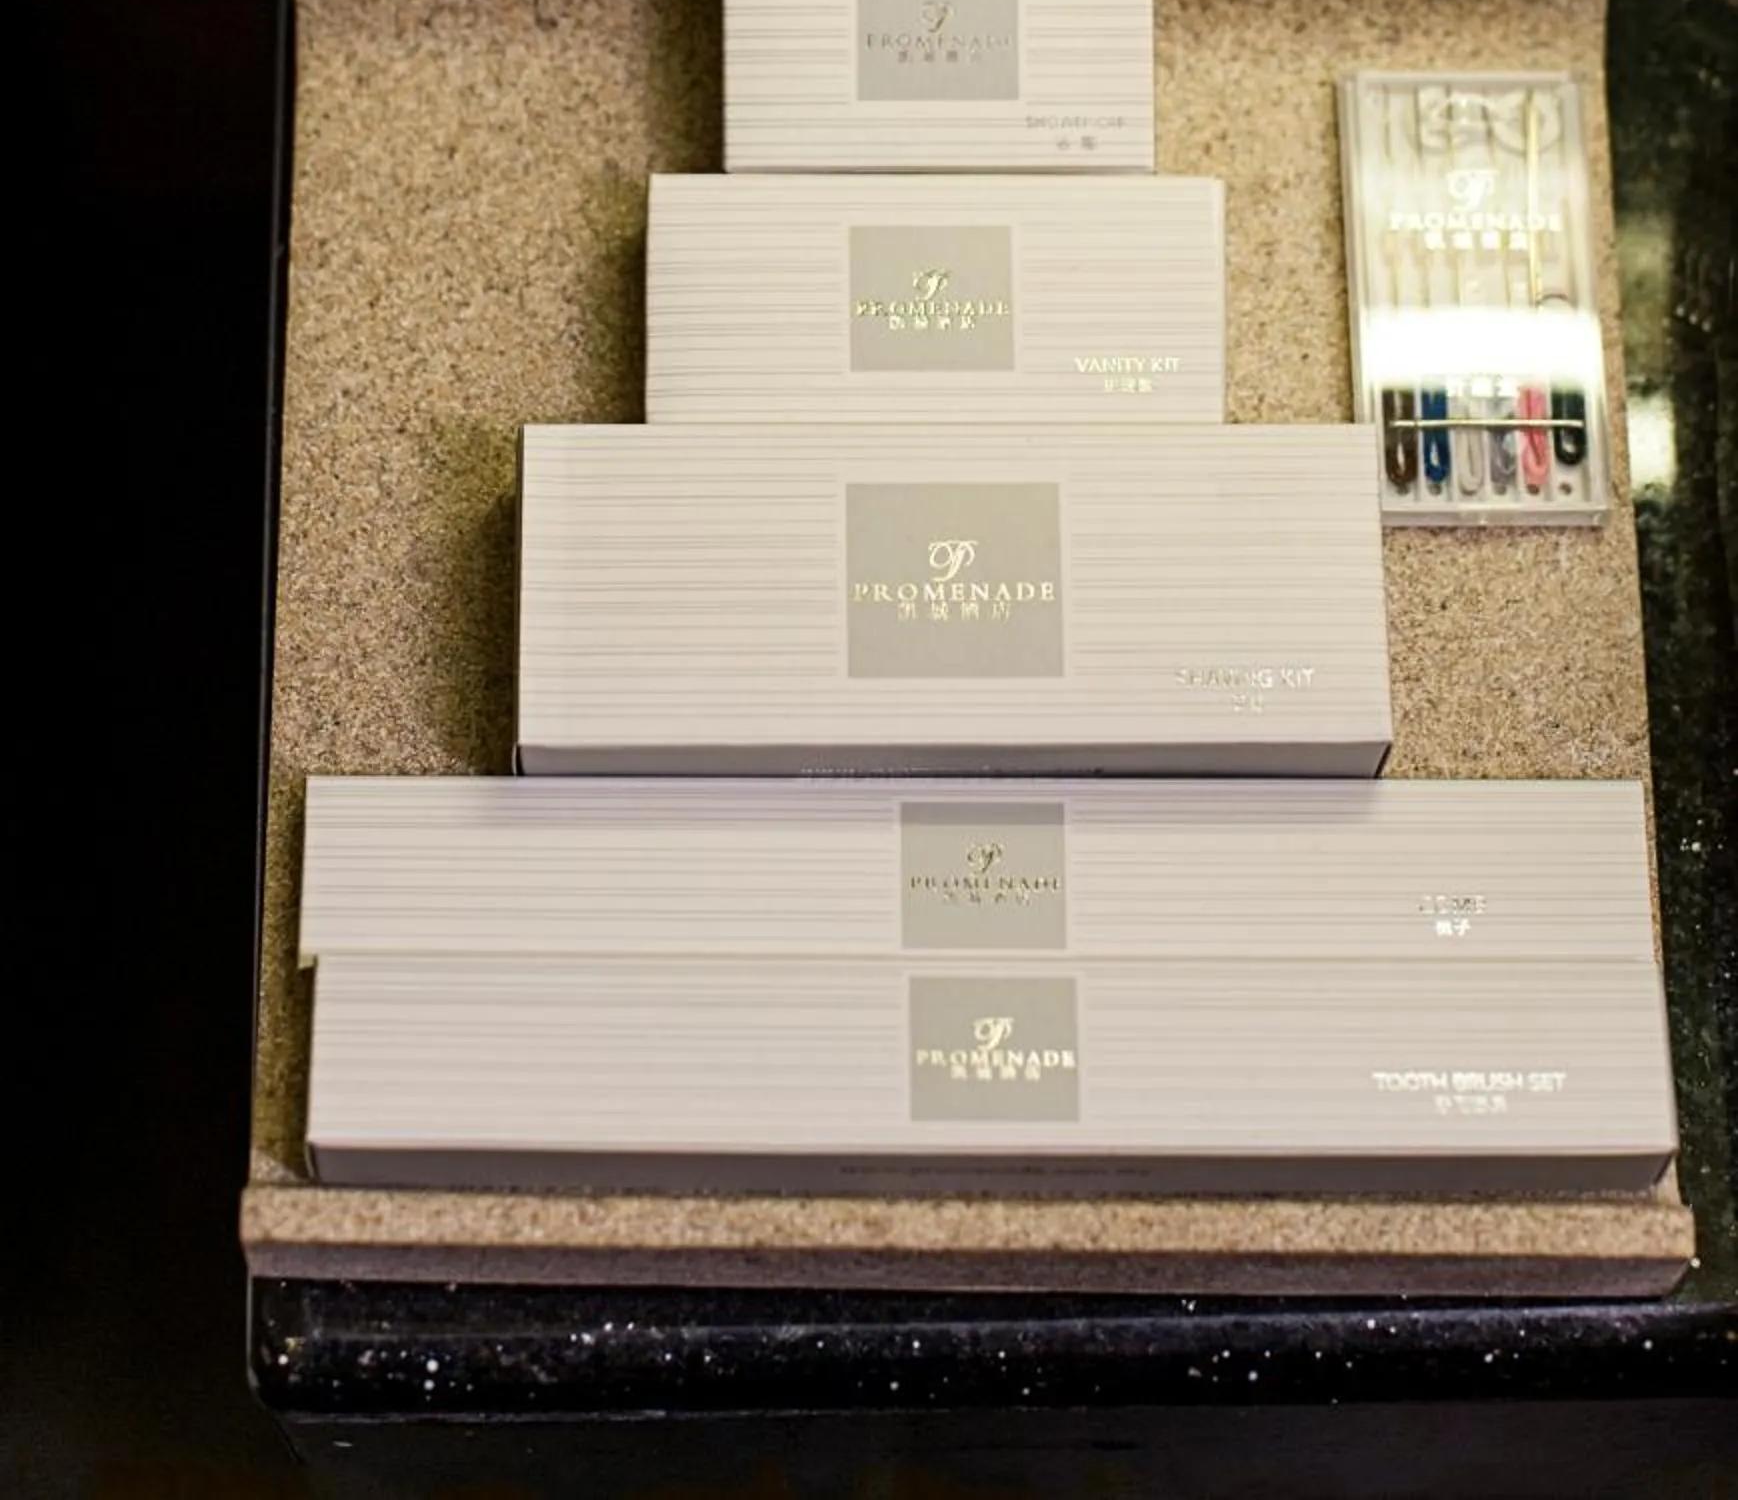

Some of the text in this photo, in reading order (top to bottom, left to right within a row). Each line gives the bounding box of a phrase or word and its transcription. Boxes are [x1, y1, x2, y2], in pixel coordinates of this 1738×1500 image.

[866, 33, 1010, 49] PROMENADE
[1390, 213, 1562, 232] PROMENADE
[856, 301, 1009, 315] PROMENADE
[1074, 357, 1180, 372] VANITY KIT
[854, 582, 1055, 601] PROMENADE
[1175, 668, 1315, 688] SHAVING KIT
[910, 876, 1060, 891] PROMENADE
[916, 1050, 1076, 1067] PROMENADE
[1373, 1072, 1566, 1092] TOOTH BRUSH SET
